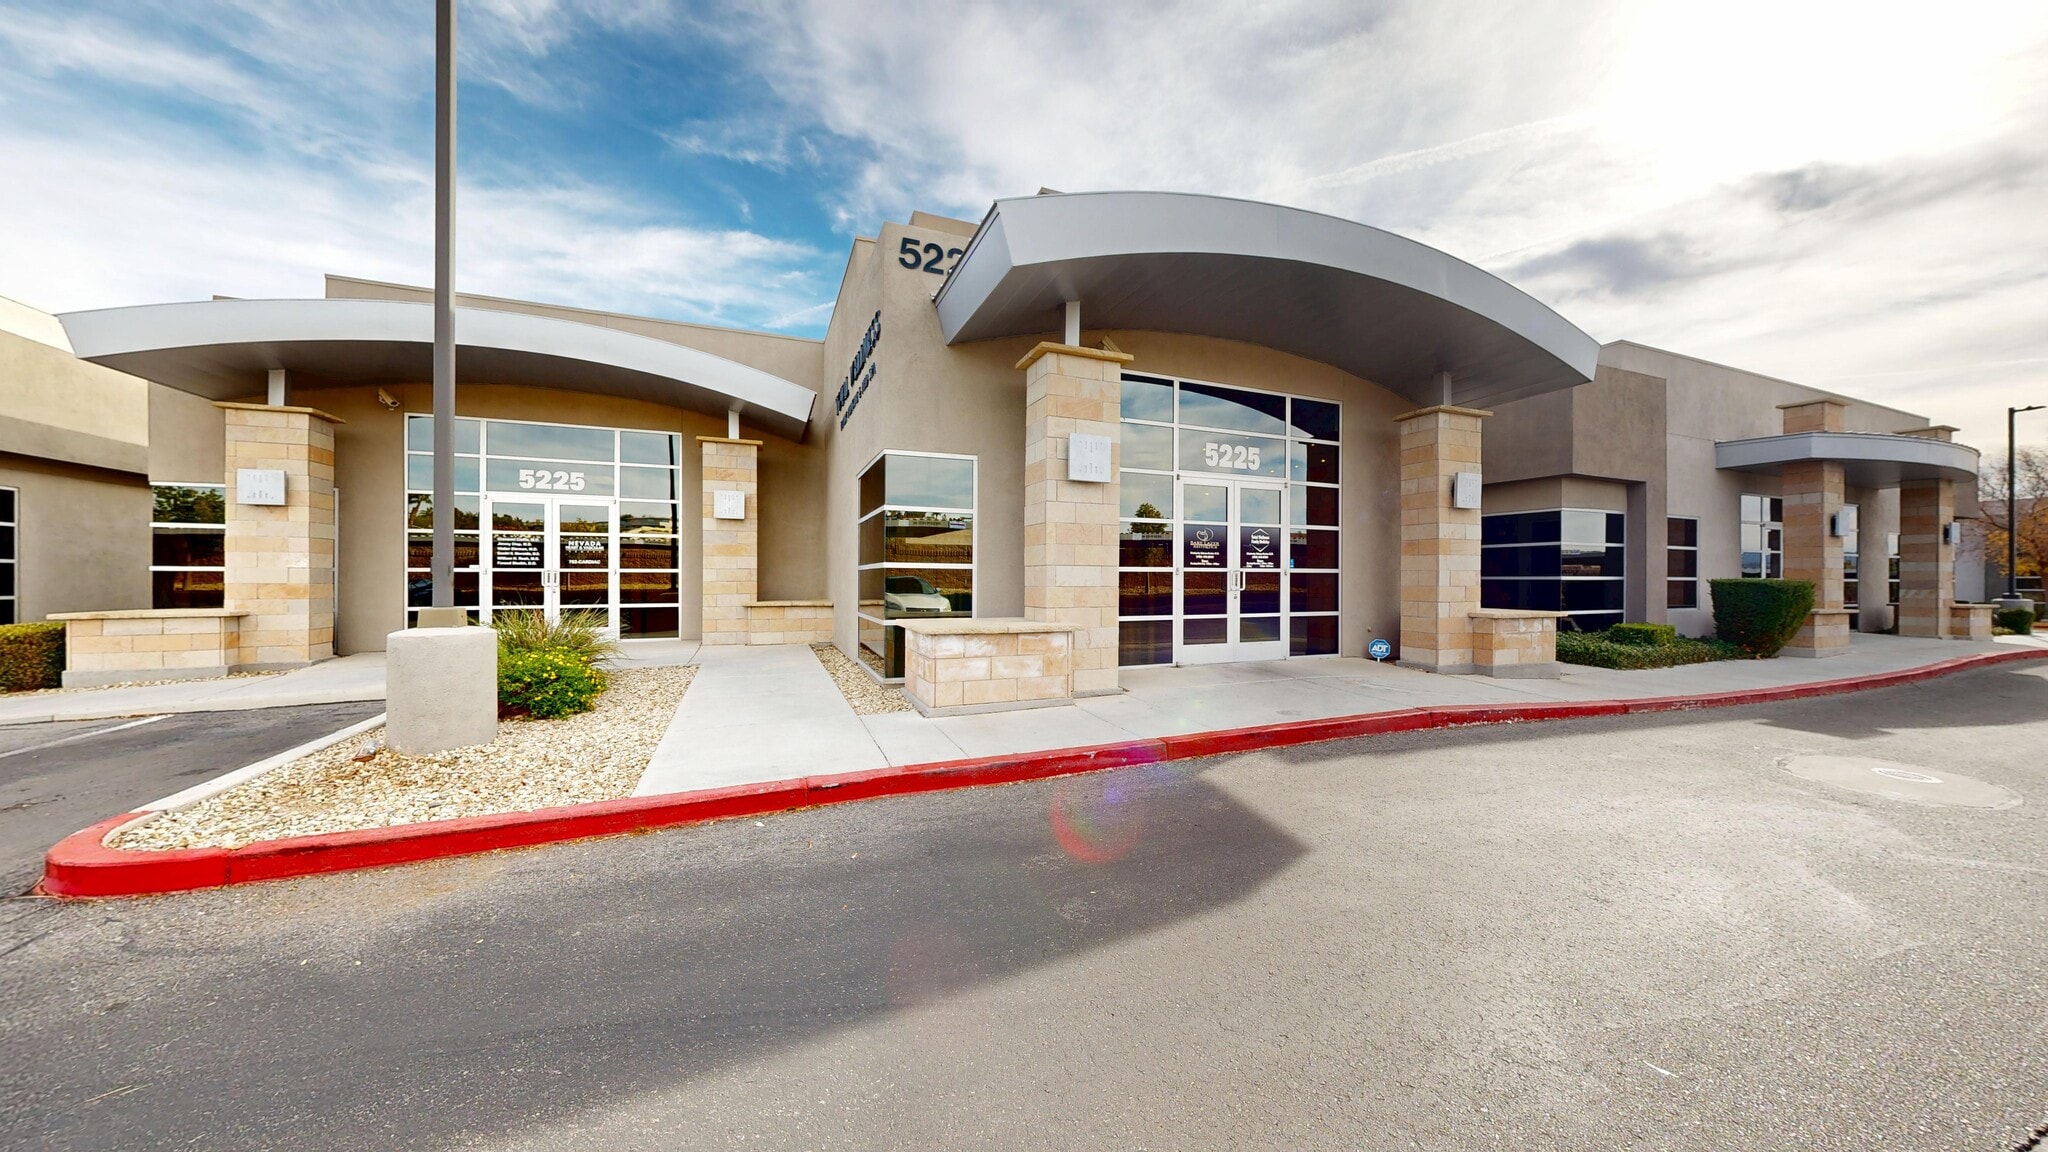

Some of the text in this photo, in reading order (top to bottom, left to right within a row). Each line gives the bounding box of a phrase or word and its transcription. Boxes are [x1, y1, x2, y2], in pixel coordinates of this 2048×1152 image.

[1205, 442, 1260, 471] 5225
[519, 469, 585, 491] 5225
[1371, 644, 1389, 653] ADT
